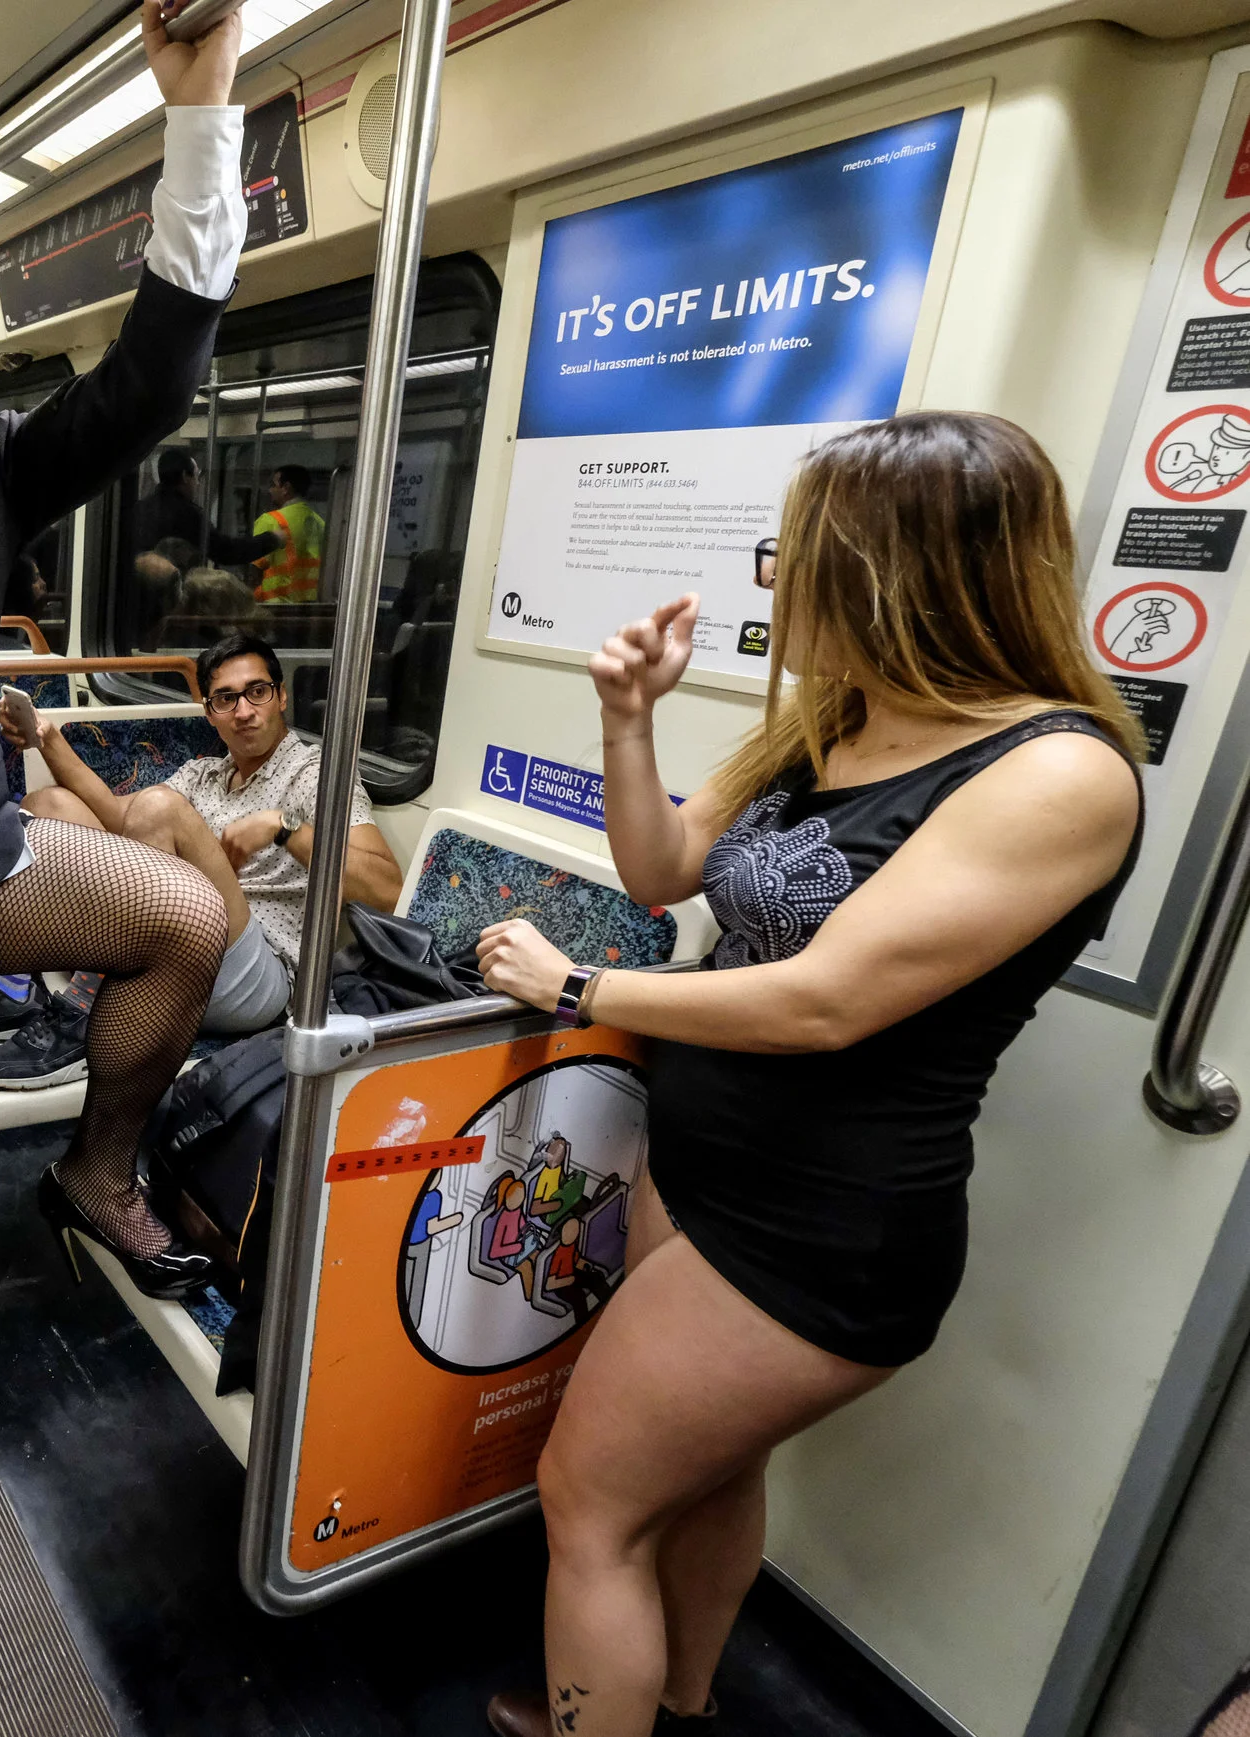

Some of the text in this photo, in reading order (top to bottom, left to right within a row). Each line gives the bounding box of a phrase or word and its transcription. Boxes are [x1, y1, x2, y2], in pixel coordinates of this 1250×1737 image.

[278, 121, 289, 148] Station
[842, 141, 937, 172] metro.net/offlimits
[556, 259, 875, 343] IT'S OFF LIMITS.
[1196, 332, 1219, 341] each
[560, 336, 812, 375] Sexual harassment is not tolerated on Metro.
[579, 462, 670, 474] GET SUPPORT.
[578, 478, 698, 490] 844.OFF.LIMITS (844.633.5464)
[574, 501, 591, 509] Sexual
[592, 501, 625, 509] harassment
[632, 502, 662, 510] unwanted
[694, 503, 728, 511] comments
[730, 503, 743, 511] and
[577, 512, 588, 520] you
[609, 512, 627, 520] victim
[628, 512, 634, 520] of
[635, 513, 654, 521] sexual
[606, 523, 622, 532] helps
[630, 523, 641, 531] talk
[654, 525, 684, 533] counselor
[1159, 522, 1205, 531] instructed
[1206, 524, 1218, 532] by
[592, 538, 619, 546] counselor
[619, 539, 647, 547] advocates
[707, 543, 715, 551] all
[642, 567, 659, 576] report
[668, 568, 683, 576] order
[522, 614, 554, 629] Metro
[1127, 682, 1148, 691] door
[1130, 691, 1163, 702] located
[533, 763, 589, 790] PRIORITY
[530, 778, 582, 804] SENIORS
[583, 794, 605, 812] AN
[528, 792, 555, 807] Personas
[555, 801, 580, 815] Mayores
[478, 1372, 550, 1408] Increase
[553, 1364, 574, 1385] yo
[473, 1388, 549, 1435] personal
[341, 1518, 380, 1539] Metro
